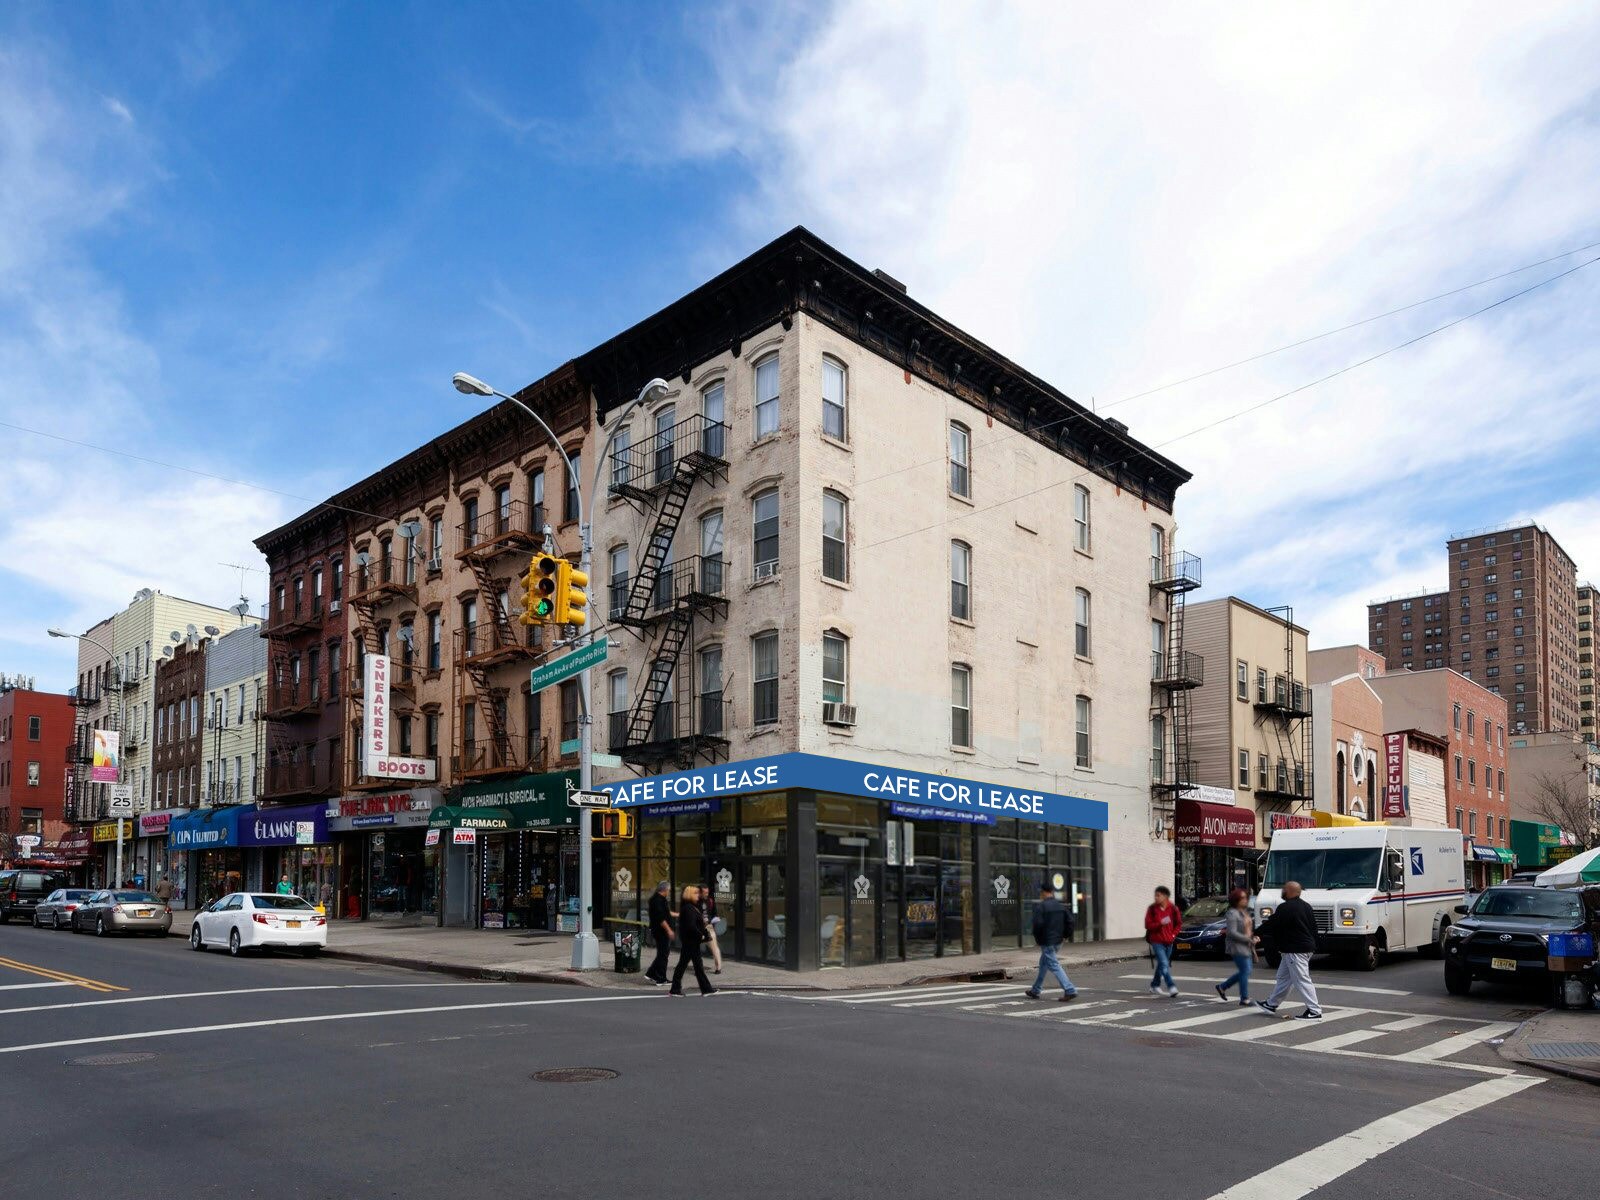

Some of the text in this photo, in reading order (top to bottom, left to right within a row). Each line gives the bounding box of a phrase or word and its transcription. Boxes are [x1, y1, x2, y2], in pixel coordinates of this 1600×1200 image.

[533, 671, 553, 685] Graham
[575, 653, 593, 666] Puerto
[593, 646, 606, 658] Rico
[374, 659, 385, 751] SNEAKERS
[378, 761, 425, 775] BOOTS
[1388, 734, 1400, 813] PERFUMES
[662, 776, 705, 798] FOR
[713, 766, 778, 791] LEASE
[461, 796, 475, 808] AVON
[475, 793, 504, 807] PHARMACY
[580, 793, 607, 803] ONE WAY
[864, 773, 920, 797] CAFE
[927, 781, 971, 805] FOR
[978, 788, 1044, 814] LEASE
[113, 797, 131, 807] 25
[339, 800, 358, 817] THE
[461, 818, 507, 828] FARMACIA
[1178, 825, 1201, 834] AVON
[1203, 817, 1227, 836] AVON
[455, 833, 474, 841] ATM
